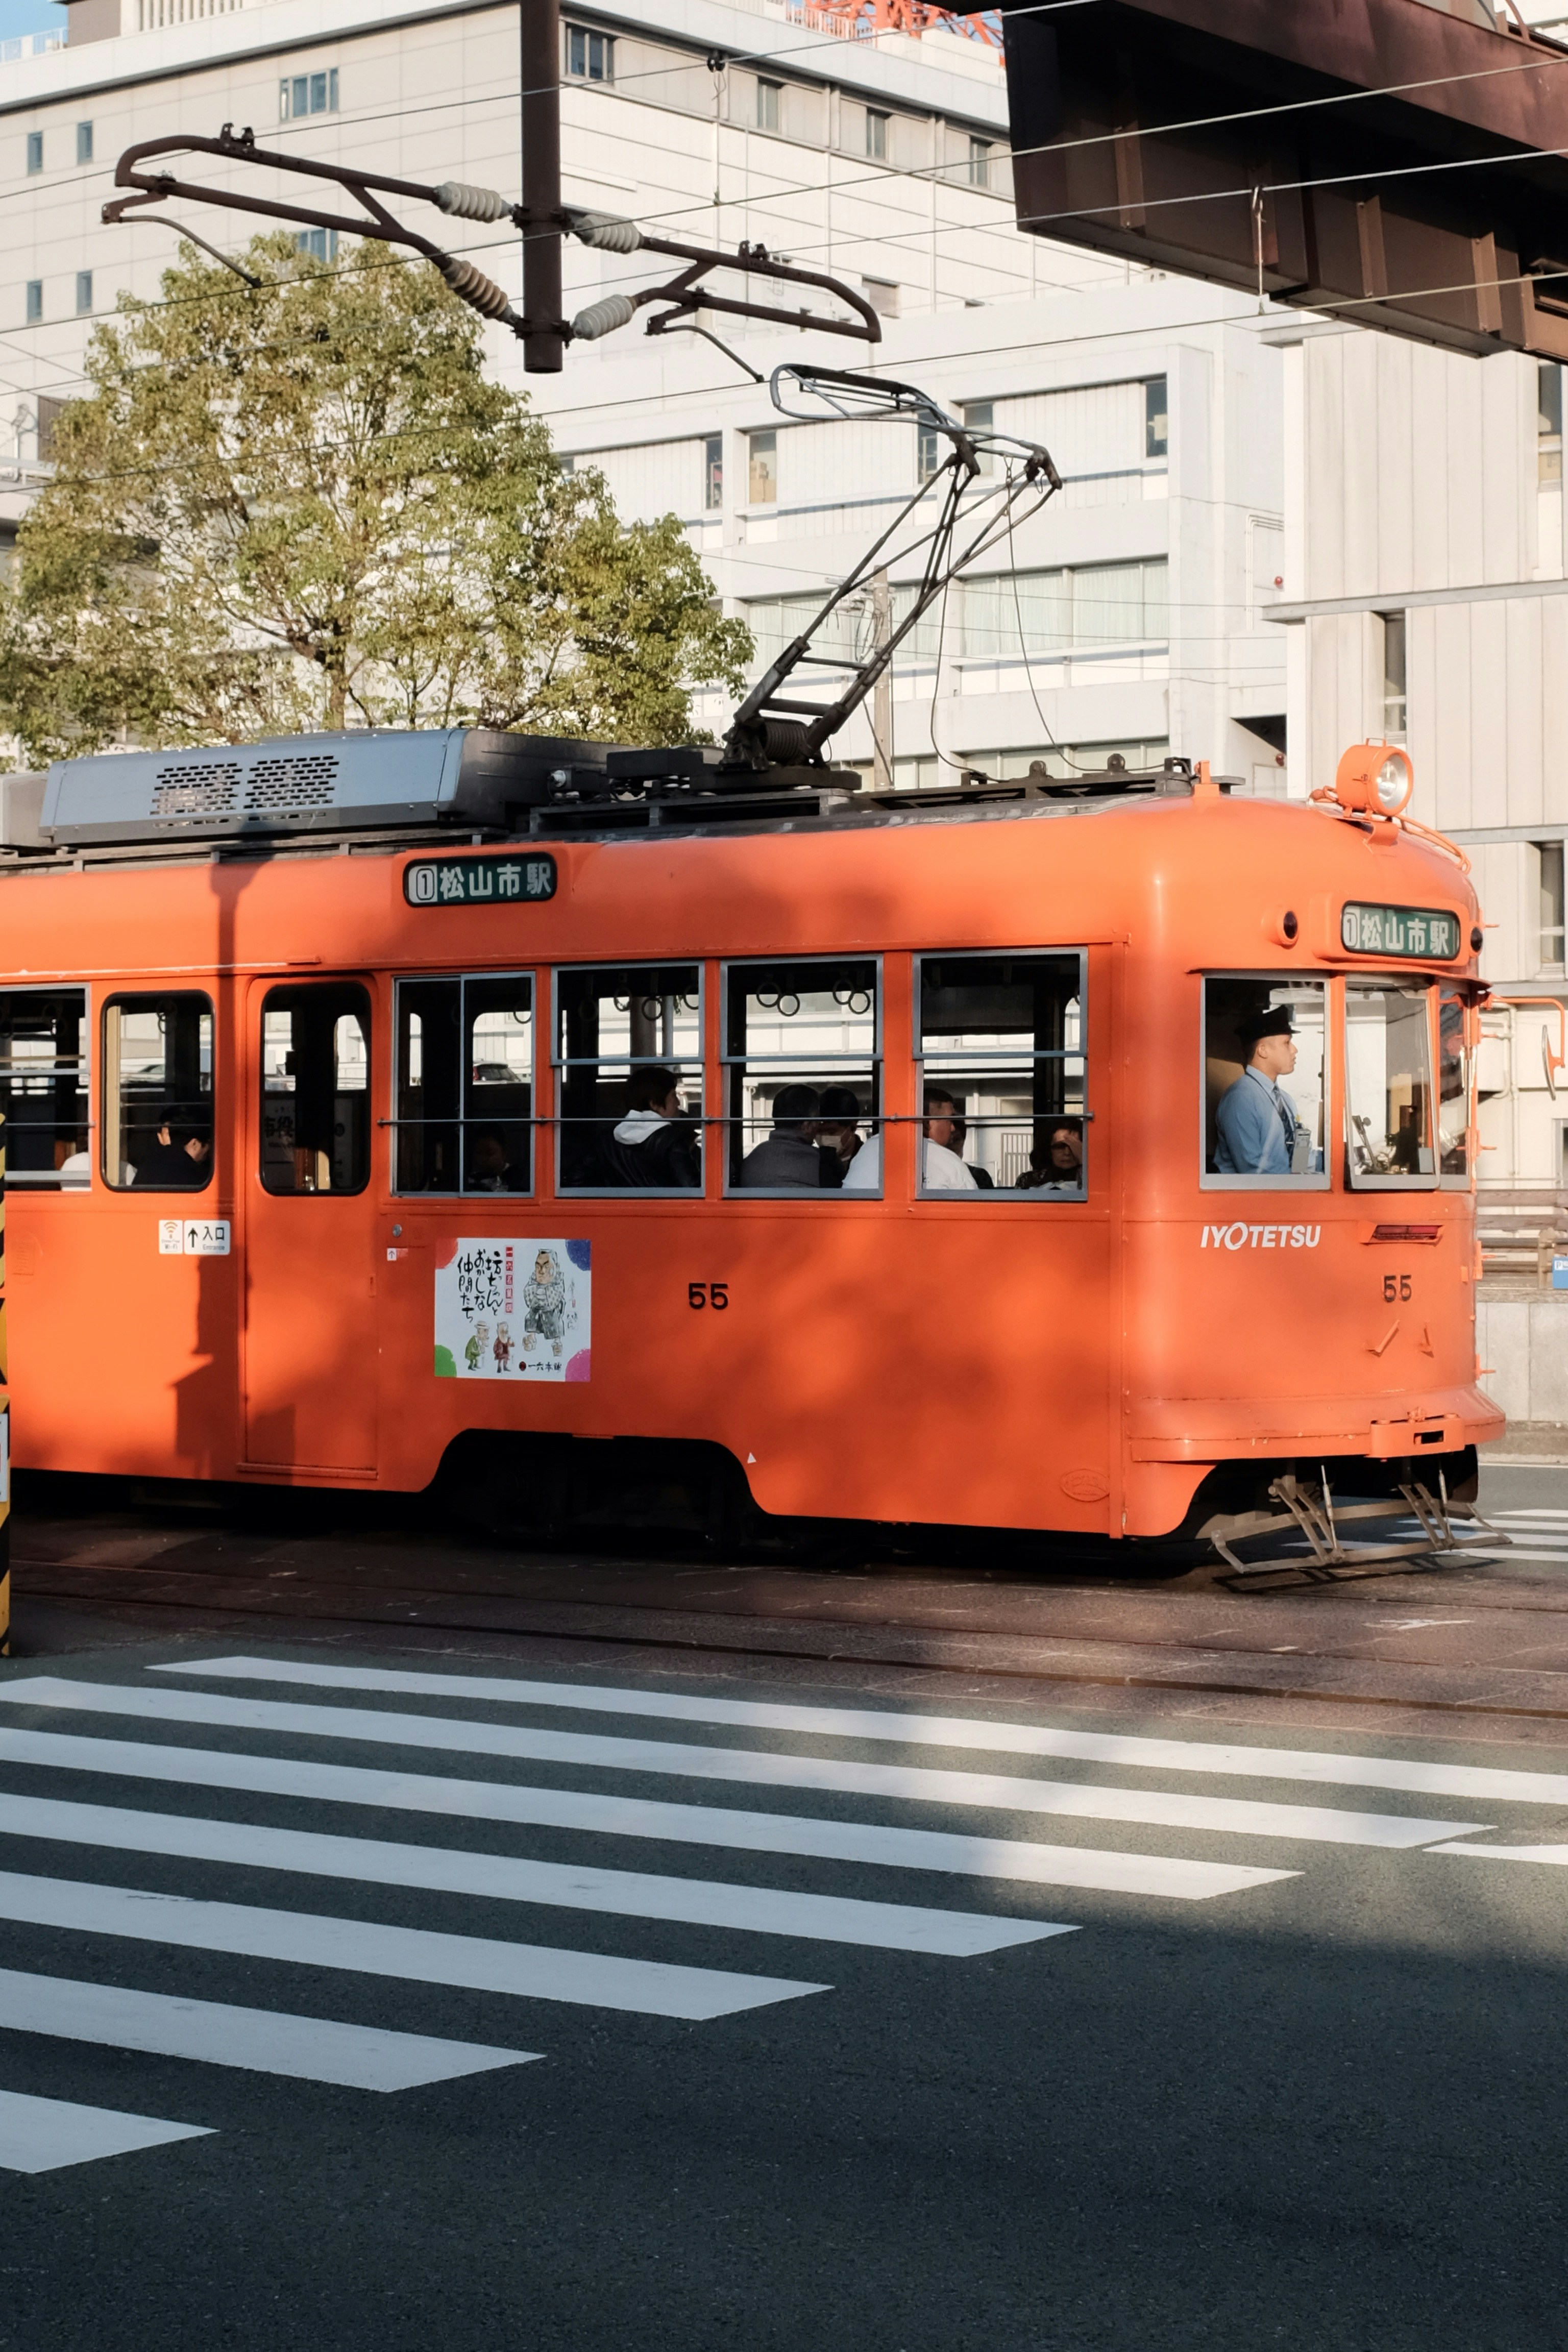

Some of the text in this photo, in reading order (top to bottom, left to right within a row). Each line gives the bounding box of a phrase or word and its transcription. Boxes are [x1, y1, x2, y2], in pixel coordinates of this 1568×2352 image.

[439, 862, 552, 900] 松山市駅
[1361, 913, 1450, 954] 松山市駅
[202, 1226, 225, 1241] 入口
[1200, 1221, 1321, 1251] IYOTETSU
[457, 1253, 475, 1323] 仲間たち
[474, 1248, 485, 1311] おかしな
[485, 1251, 503, 1316] 坊っちゃんと
[688, 1283, 729, 1310] 55
[1383, 1275, 1412, 1303] 55
